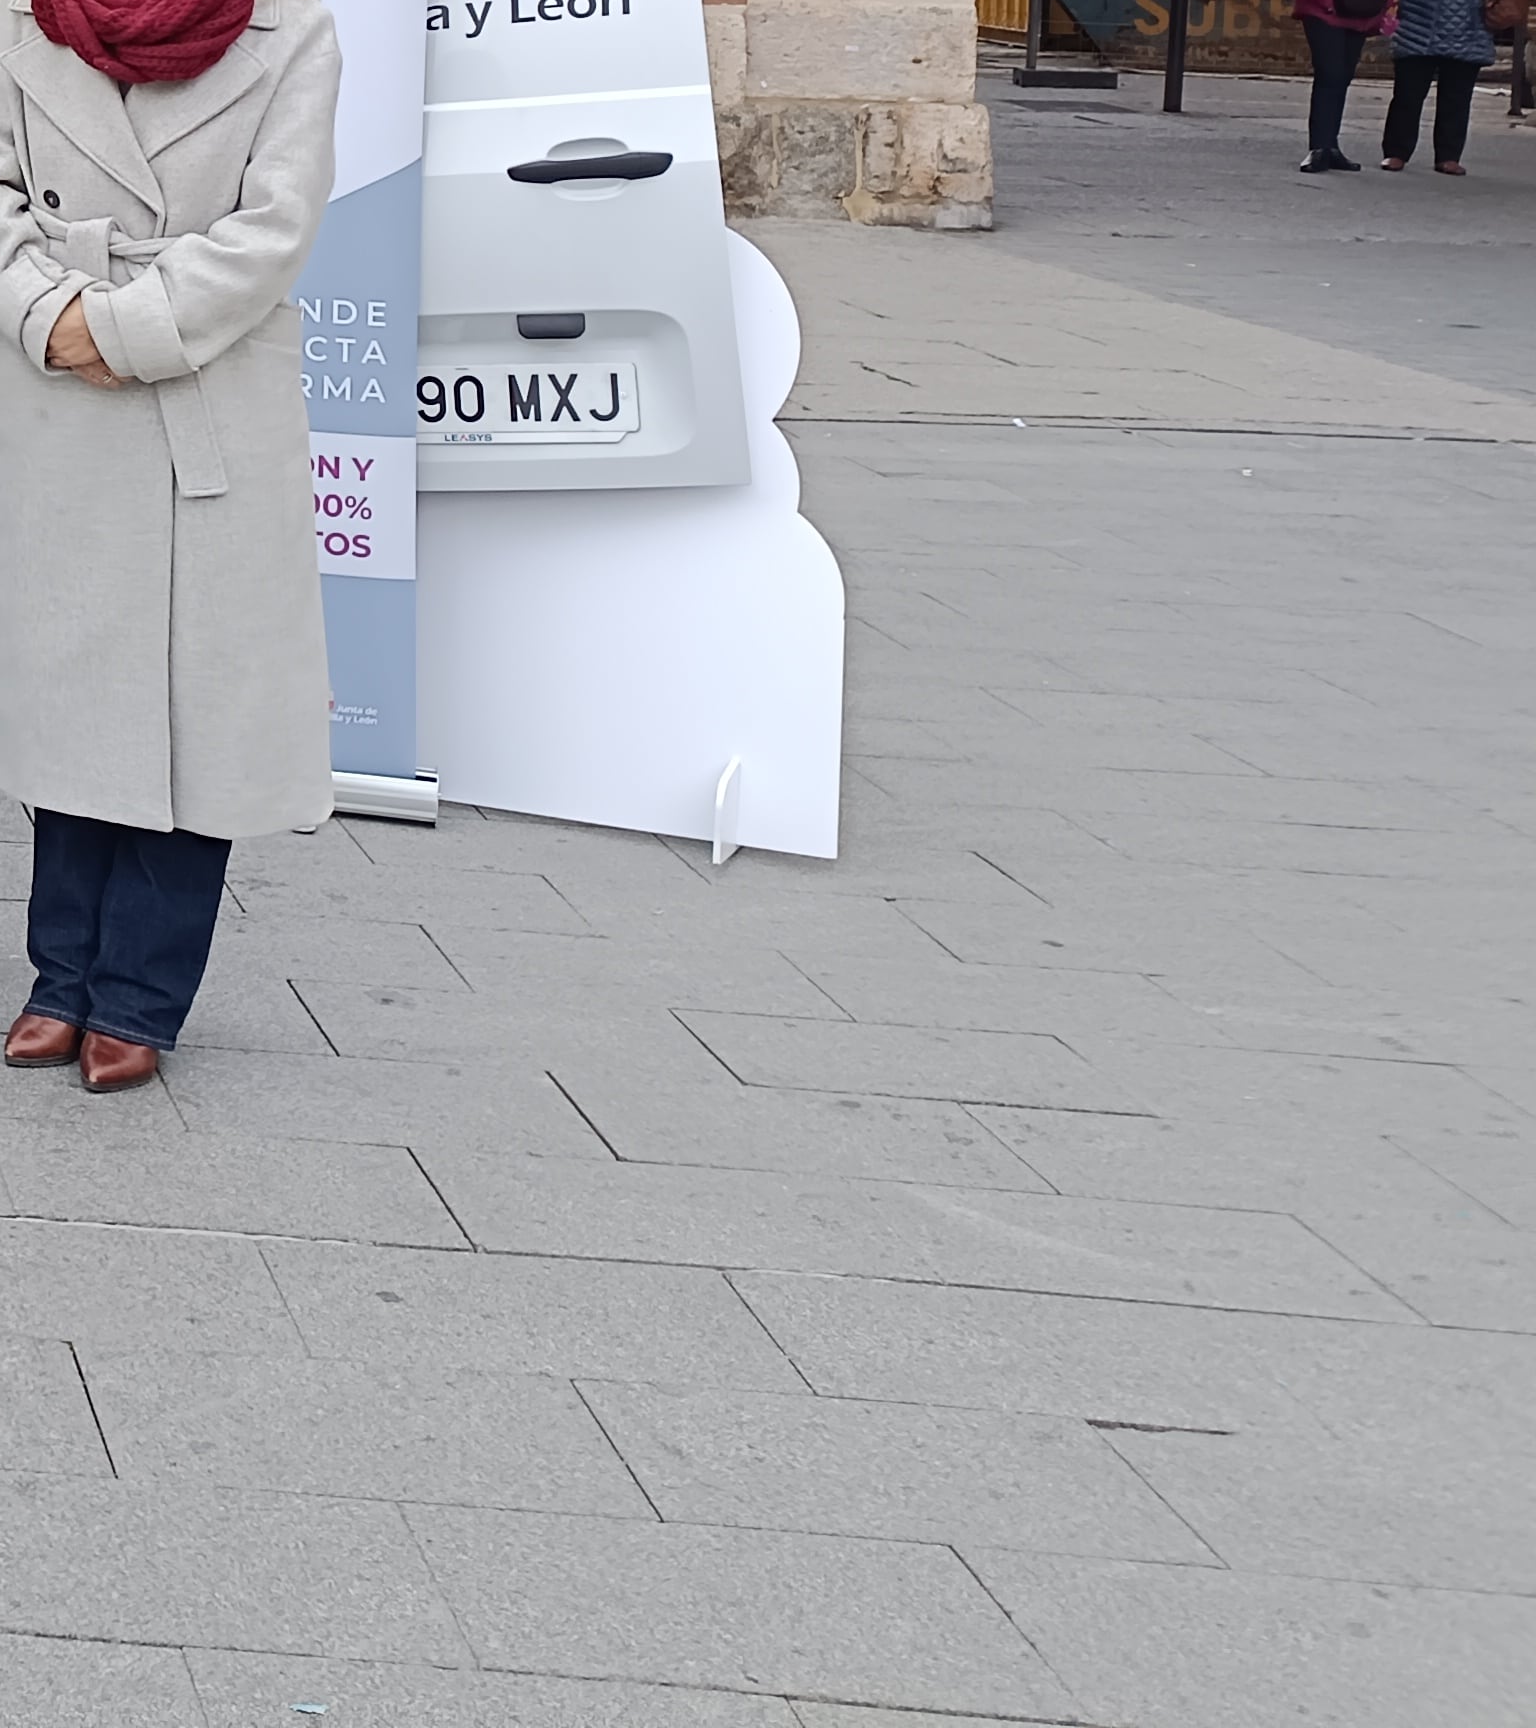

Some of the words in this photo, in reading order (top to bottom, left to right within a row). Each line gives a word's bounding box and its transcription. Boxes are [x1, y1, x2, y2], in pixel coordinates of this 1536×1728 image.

[465, 0, 493, 39] y
[417, 375, 485, 423] 90
[508, 373, 620, 423] MXJ
[444, 433, 493, 443] LEASYS
[310, 455, 341, 480] N
[351, 457, 375, 481] Y
